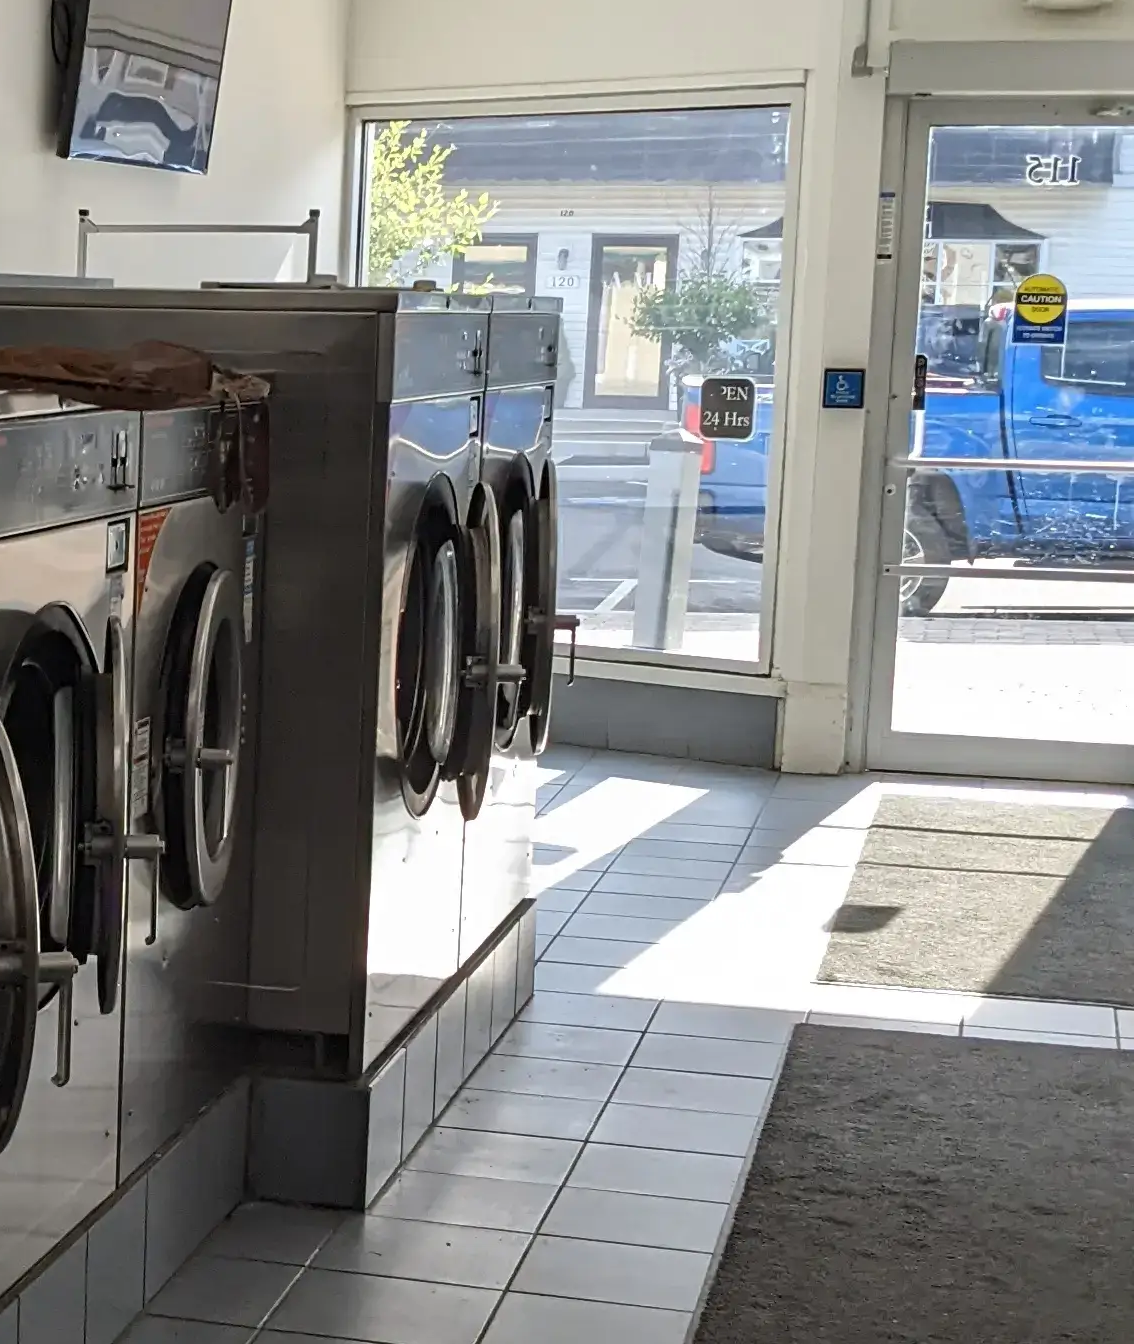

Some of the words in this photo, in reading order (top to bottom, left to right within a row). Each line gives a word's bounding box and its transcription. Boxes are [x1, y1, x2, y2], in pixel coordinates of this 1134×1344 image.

[552, 276, 574, 287] 120
[1021, 294, 1062, 303] CAUTION
[703, 411, 719, 425] 24
[723, 411, 750, 426] Hrs
